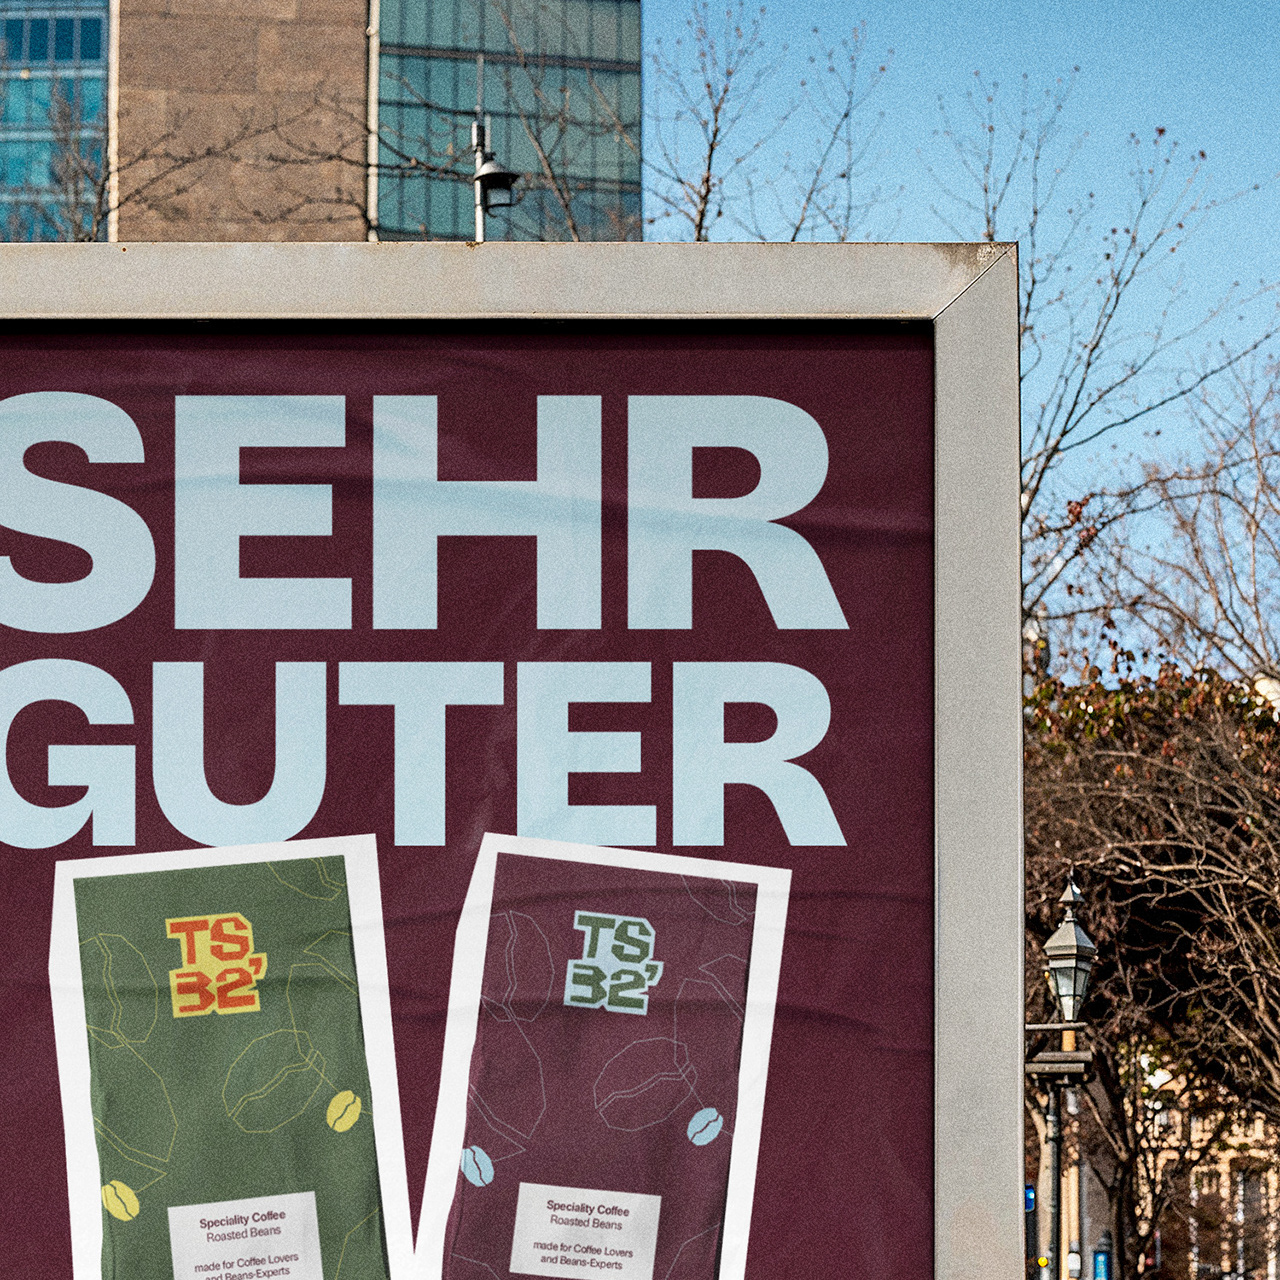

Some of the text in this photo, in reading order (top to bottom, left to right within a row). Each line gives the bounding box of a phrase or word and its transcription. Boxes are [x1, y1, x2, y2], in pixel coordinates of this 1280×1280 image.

[170, 917, 251, 964] TS
[577, 915, 652, 963] TS
[547, 1200, 629, 1216] Speciality Coffee
[200, 1210, 286, 1230] Speciality Coffee
[550, 1215, 622, 1230] Roasted Beans
[207, 1226, 281, 1242] Roasted Beans
[534, 1241, 633, 1258] made for Coffee Lovers
[195, 1253, 299, 1272] made for Coffee Lovers
[541, 1254, 623, 1270] and Beans-Experts
